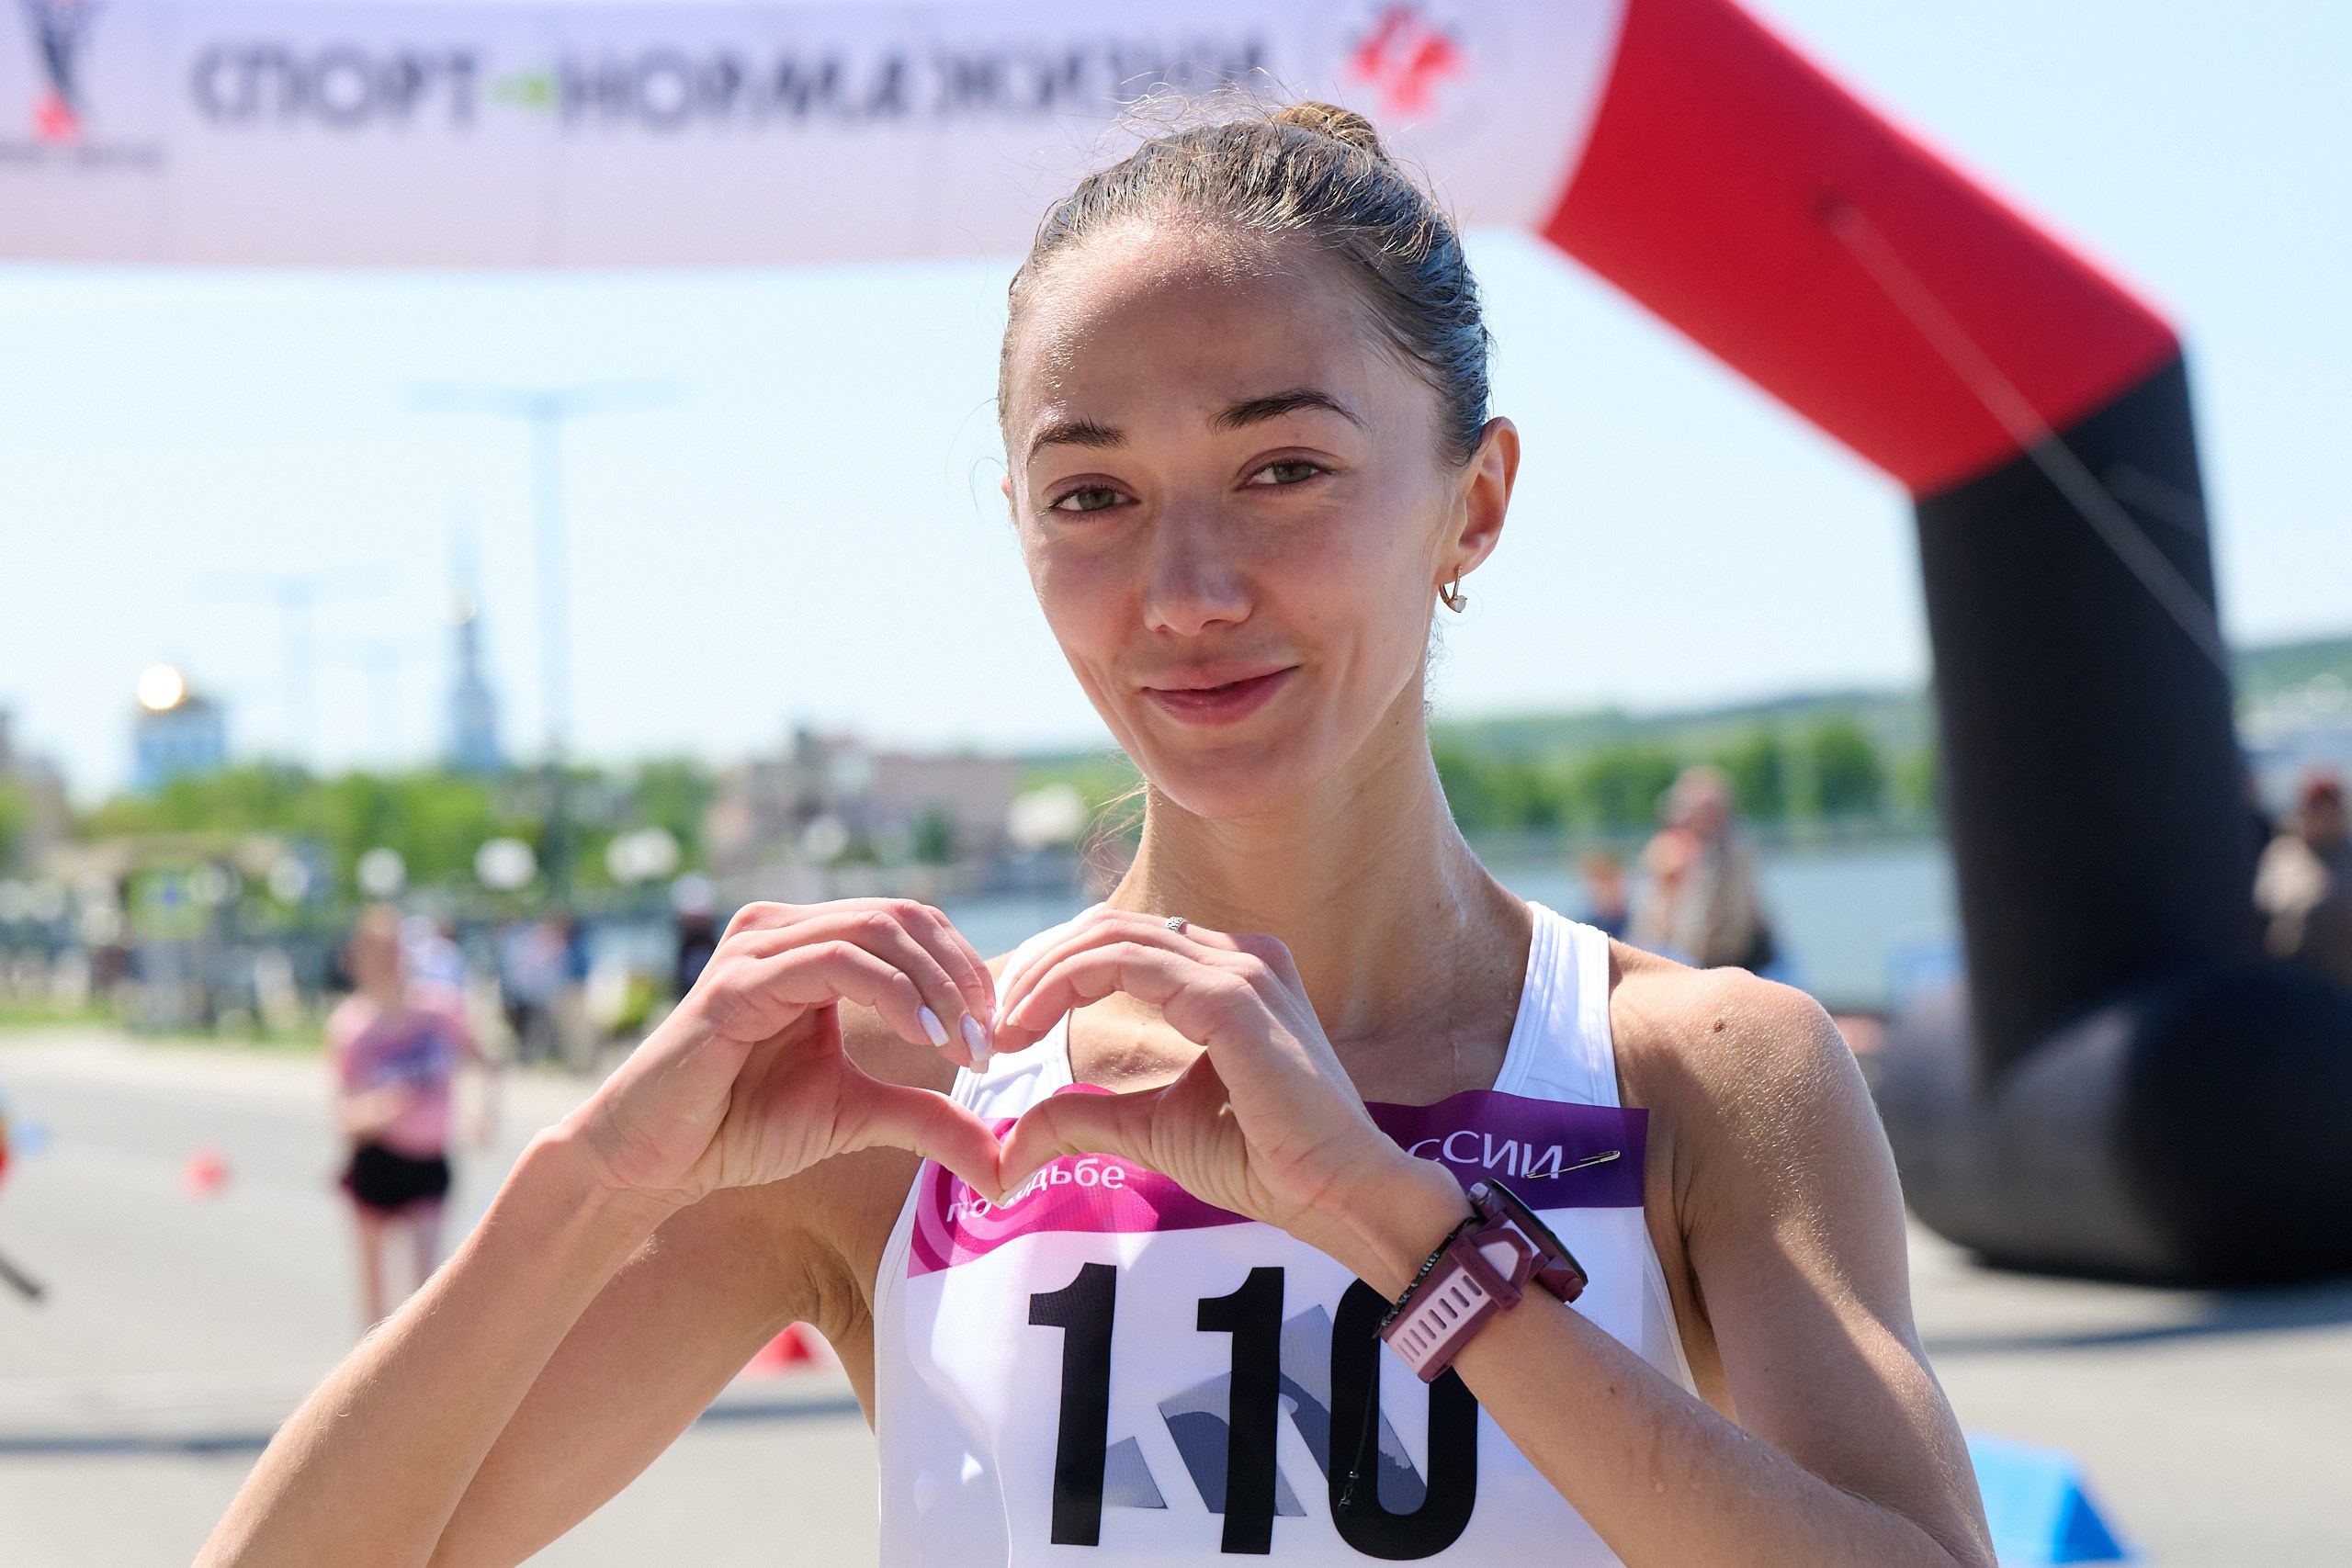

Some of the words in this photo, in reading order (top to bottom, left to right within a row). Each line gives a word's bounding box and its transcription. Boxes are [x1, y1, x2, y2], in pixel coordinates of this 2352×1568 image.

[190, 42, 481, 129] СПОРТ
[557, 44, 913, 132] НОРМА
[1406, 1130, 1563, 1180] ССИИ
[946, 1197, 992, 1223] по
[1029, 1262, 1479, 1560] 110
